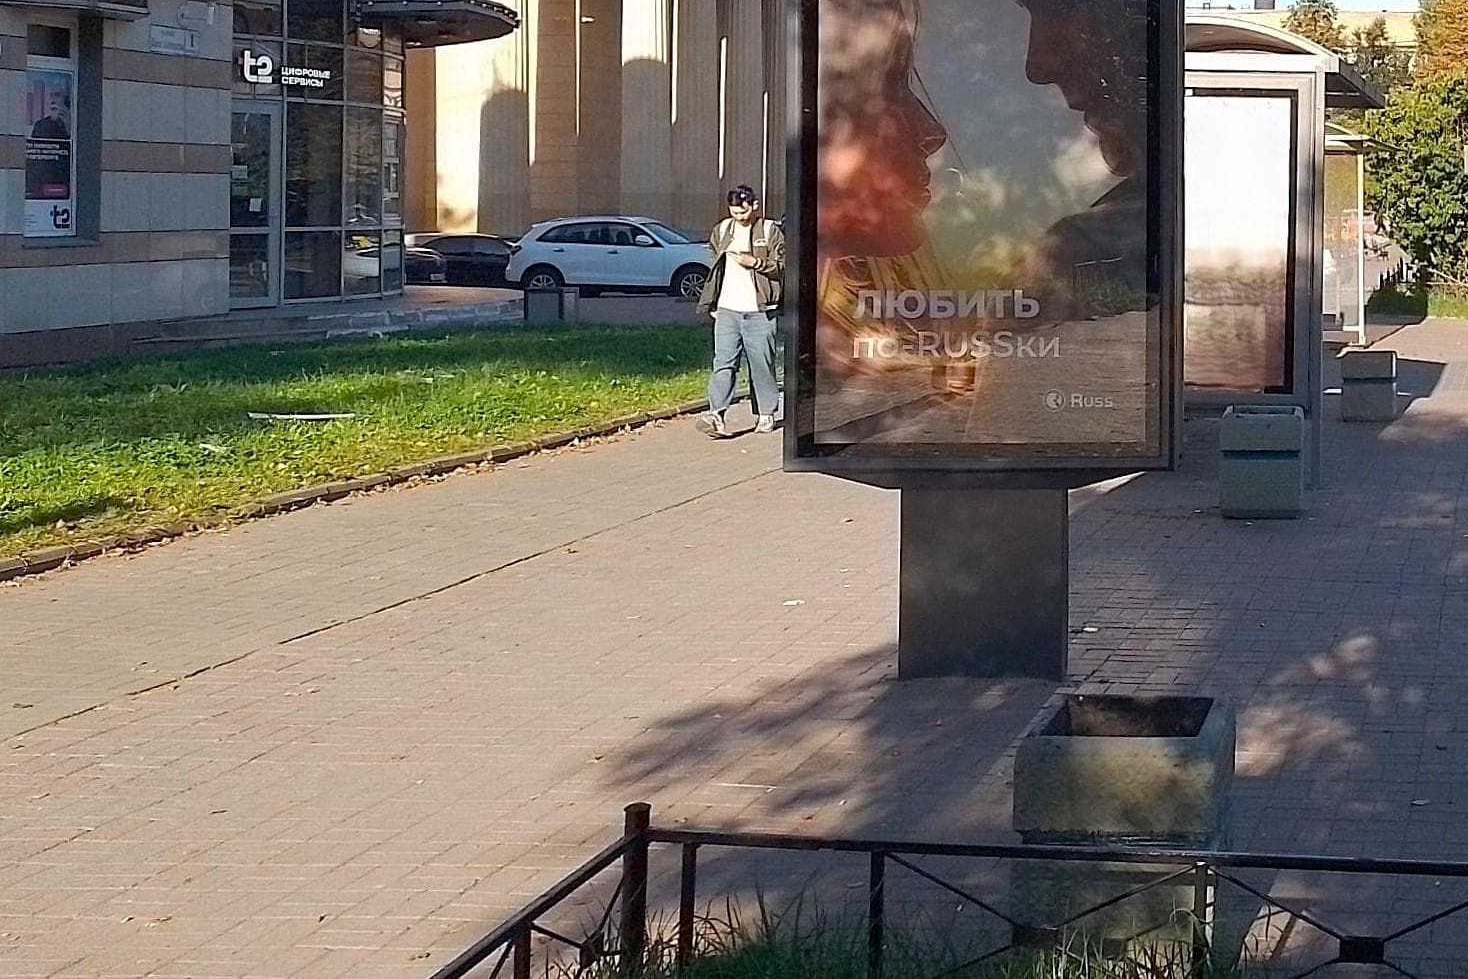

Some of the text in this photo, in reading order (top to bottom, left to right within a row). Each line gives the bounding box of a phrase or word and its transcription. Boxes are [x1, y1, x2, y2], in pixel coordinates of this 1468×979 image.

[243, 50, 273, 84] t2
[281, 66, 331, 79] ЦИФРОВЫЕ
[281, 76, 324, 88] СЕРВИСЫ
[854, 289, 1041, 319] ЛЮБИТЬ
[853, 330, 1062, 359] по-RUSSки
[1070, 393, 1114, 408] Russ
